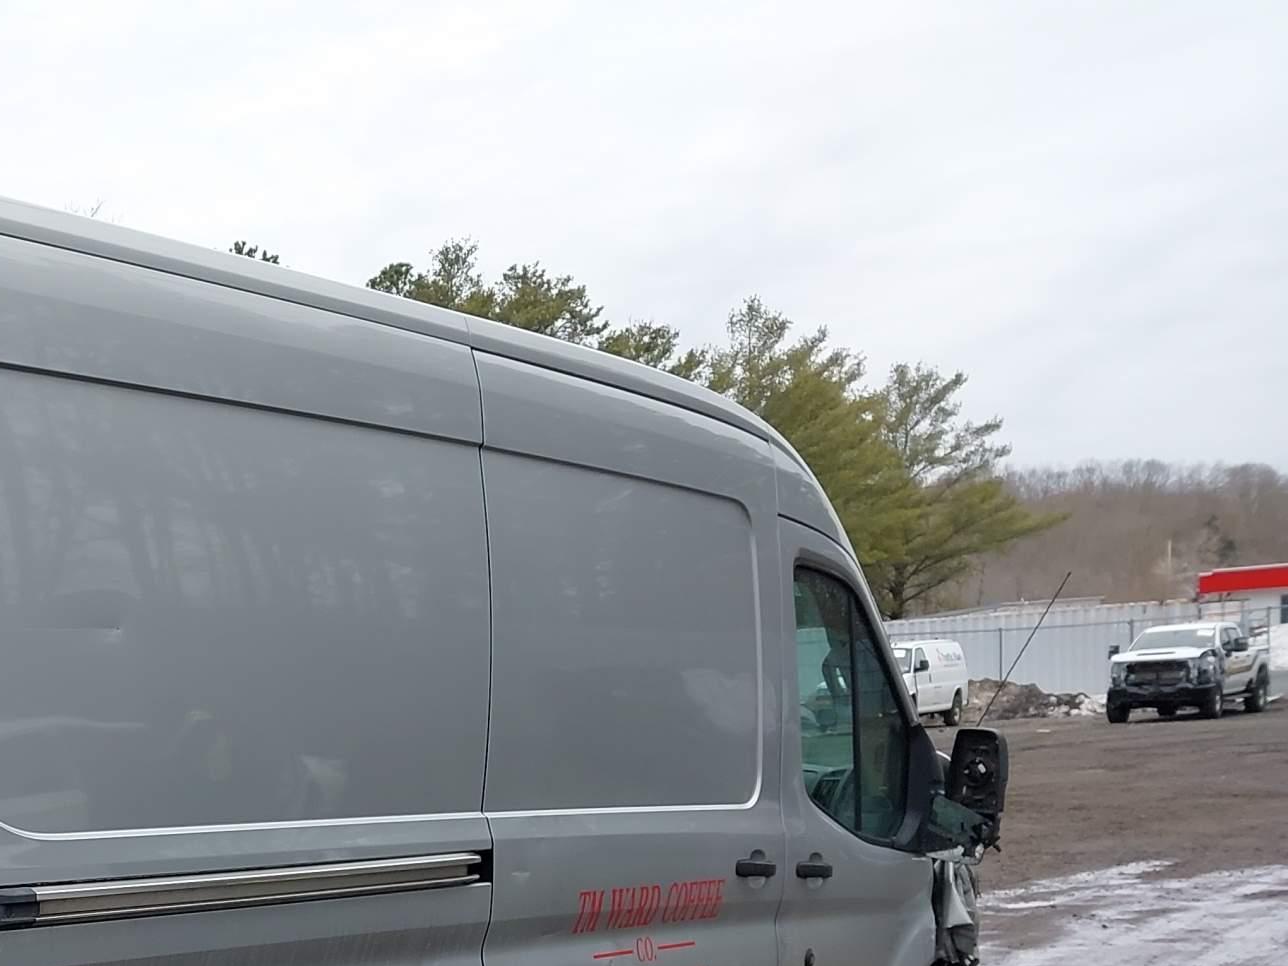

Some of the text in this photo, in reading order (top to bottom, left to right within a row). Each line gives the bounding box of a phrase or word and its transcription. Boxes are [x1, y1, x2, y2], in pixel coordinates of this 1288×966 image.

[608, 884, 661, 929] WARD
[662, 879, 726, 924] COFFEE
[636, 936, 657, 962] CO.
